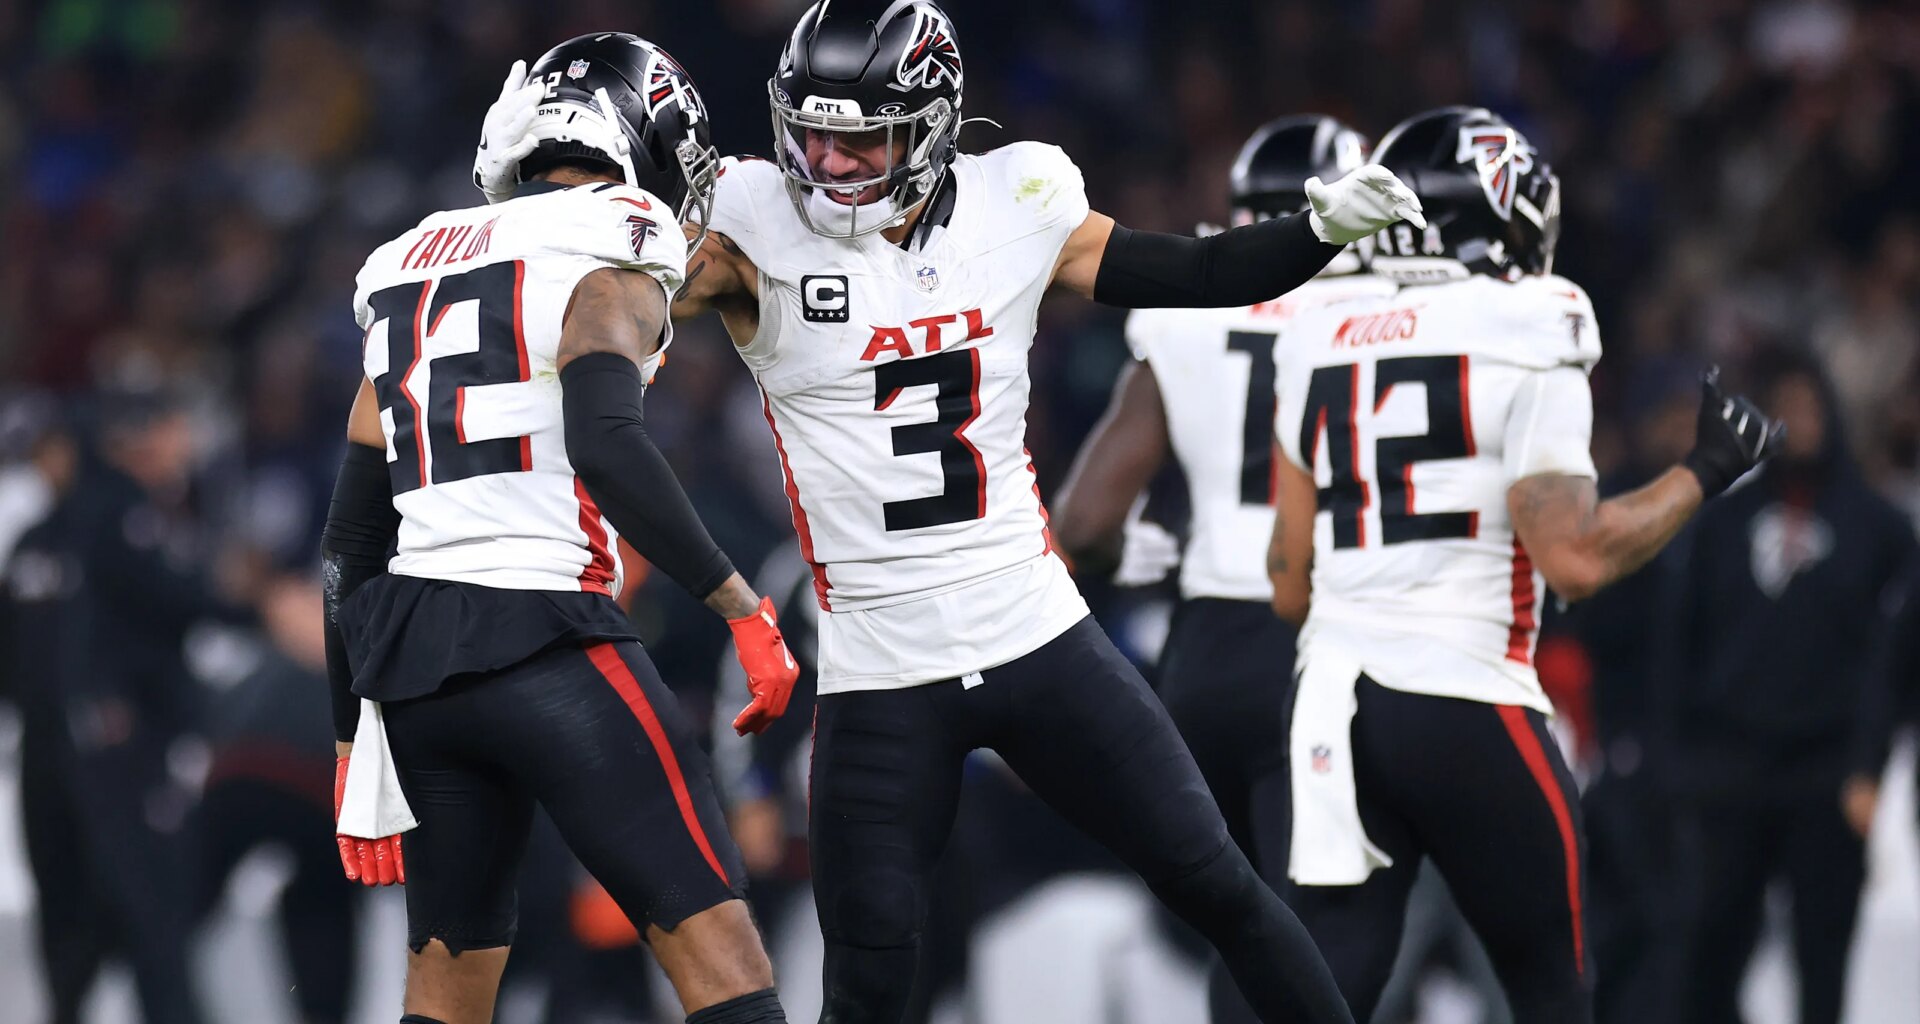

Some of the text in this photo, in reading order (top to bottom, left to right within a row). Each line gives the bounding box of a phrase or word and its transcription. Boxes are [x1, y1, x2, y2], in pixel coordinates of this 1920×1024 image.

[538, 108, 561, 116] ONS
[814, 102, 845, 115] ATL
[401, 214, 501, 270] TAYLOR
[805, 278, 846, 310] C
[860, 308, 994, 362] ATL
[1331, 308, 1417, 349] WOODS
[874, 347, 987, 532] 3
[1299, 354, 1479, 550] 42
